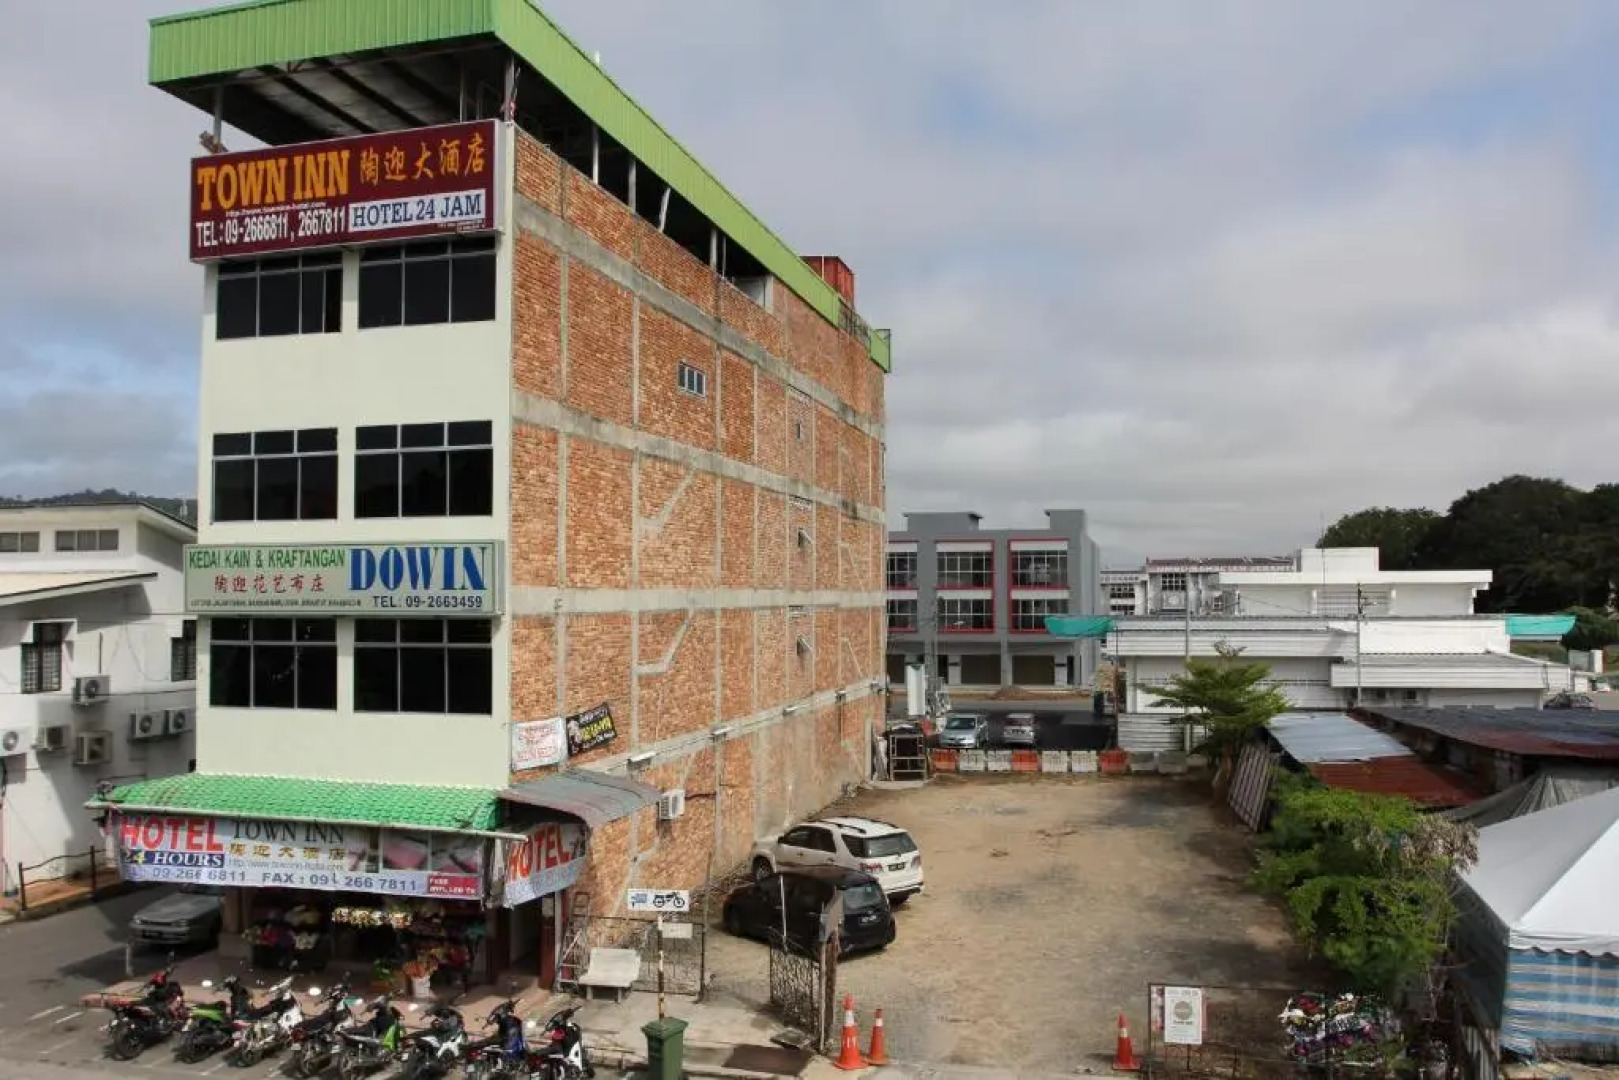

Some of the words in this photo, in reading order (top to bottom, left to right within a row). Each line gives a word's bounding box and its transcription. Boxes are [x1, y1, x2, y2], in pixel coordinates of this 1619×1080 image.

[197, 157, 289, 212] TOWN
[293, 149, 350, 201] INN
[298, 205, 346, 237] 2667811
[352, 201, 413, 228] HOTEL
[415, 198, 436, 221] 24
[440, 193, 482, 218] JAM
[189, 549, 221, 568] KEDAI
[225, 549, 250, 568] KAIN
[255, 549, 263, 568] &
[268, 548, 345, 567] KRAFTANGAN
[348, 546, 488, 591] DOWIN
[405, 596, 483, 608] 09-2663459
[122, 815, 224, 852] HOTEL
[234, 819, 297, 842] TOWN
[304, 819, 344, 843] INN
[152, 851, 223, 867] HOURS
[506, 825, 571, 883] HOTEL
